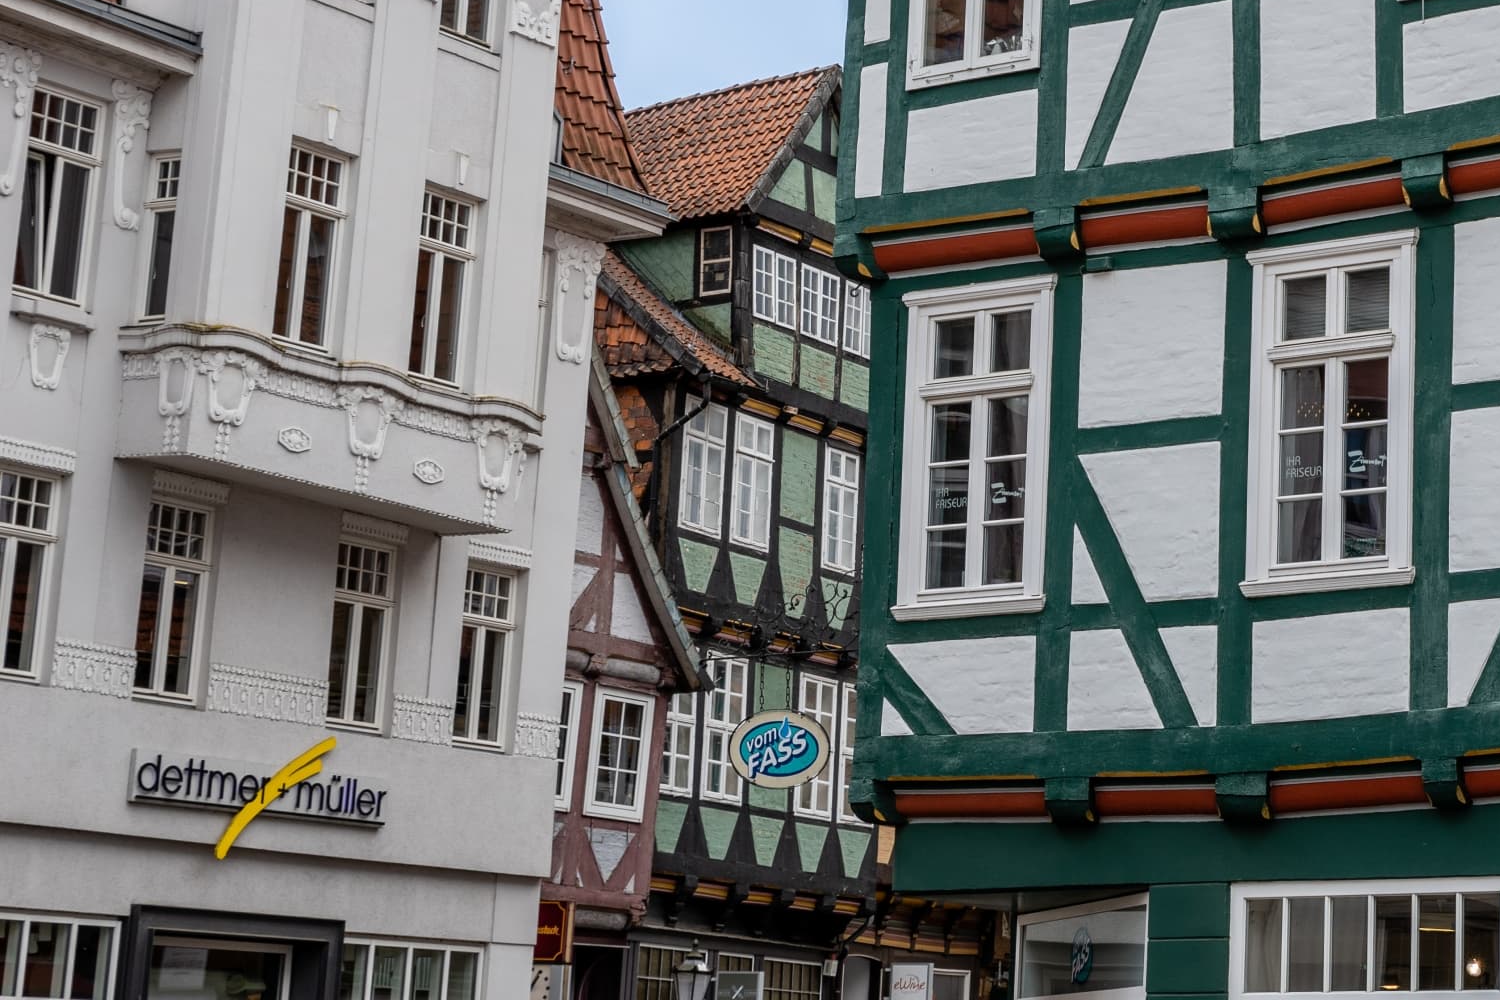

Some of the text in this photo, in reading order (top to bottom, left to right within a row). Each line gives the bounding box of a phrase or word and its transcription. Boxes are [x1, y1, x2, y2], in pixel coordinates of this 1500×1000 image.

[1286, 455, 1301, 467] IHR
[1286, 465, 1322, 479] FRISEUR
[935, 487, 949, 498] IHR
[935, 496, 967, 509] FRISEUR
[746, 727, 777, 753] vom
[747, 728, 807, 778] FASS
[137, 754, 272, 805] dettmer
[295, 775, 388, 817] müller
